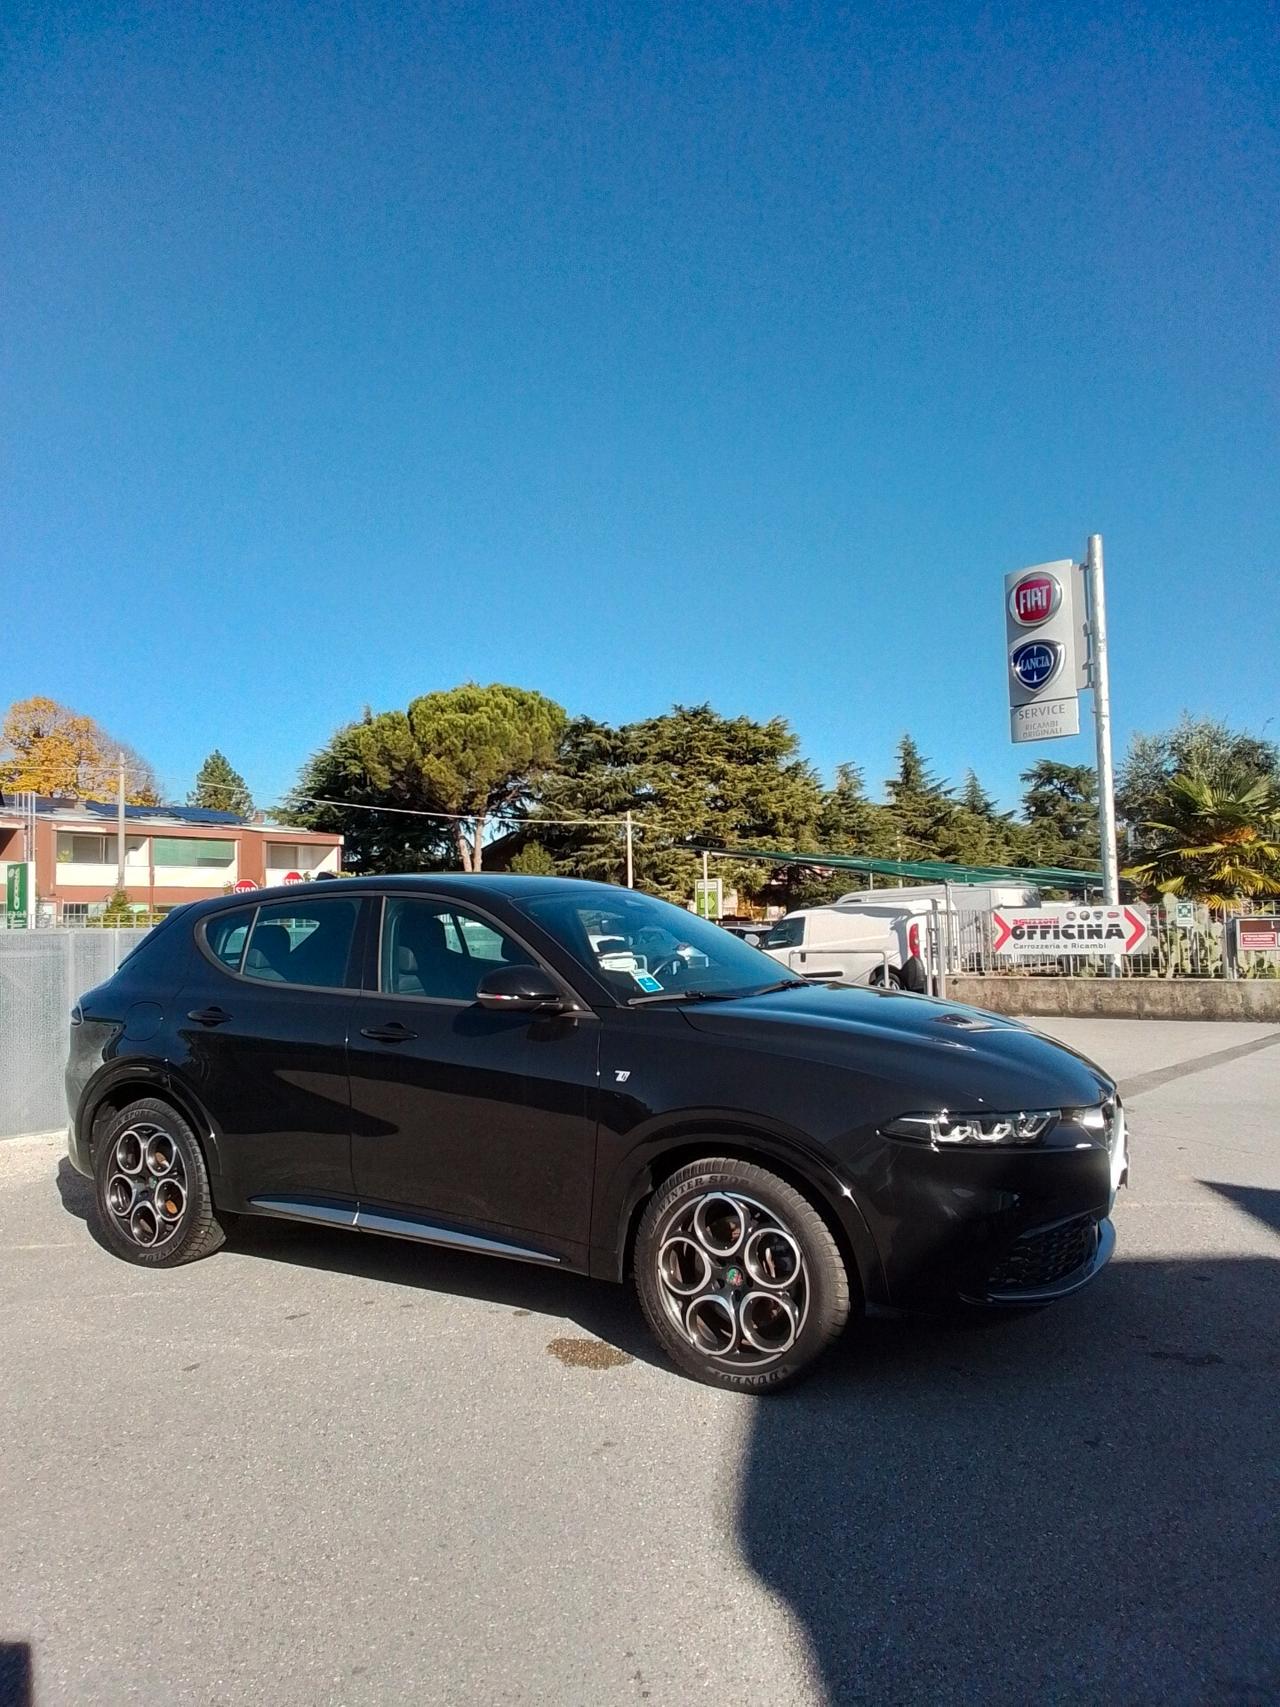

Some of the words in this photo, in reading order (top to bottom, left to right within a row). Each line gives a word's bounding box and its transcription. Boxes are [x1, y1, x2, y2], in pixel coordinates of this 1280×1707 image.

[1019, 584, 1049, 614] FIAT
[1020, 654, 1050, 672] LANCIA
[1018, 704, 1065, 720] SERVICE
[1022, 728, 1062, 739] ORIGINALI
[1025, 720, 1058, 731] RICAMBI
[1011, 923, 1126, 941] OFFICINA
